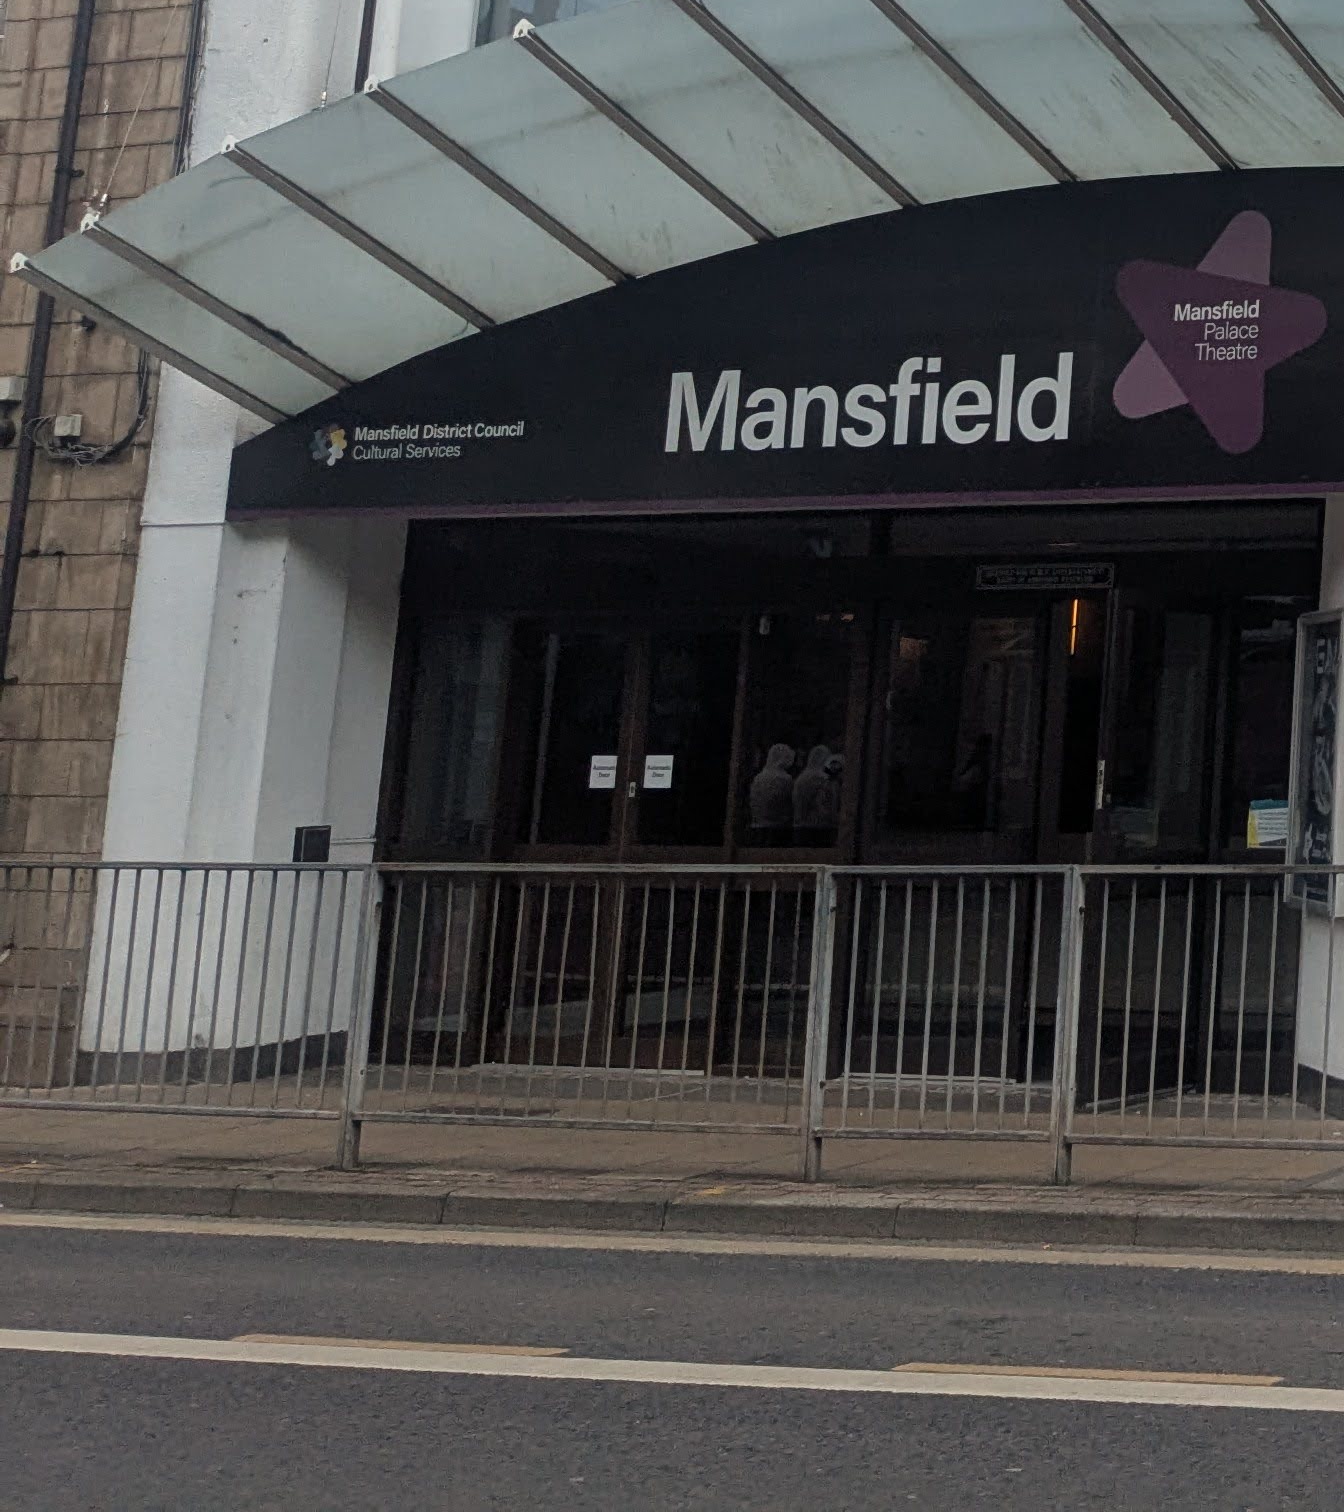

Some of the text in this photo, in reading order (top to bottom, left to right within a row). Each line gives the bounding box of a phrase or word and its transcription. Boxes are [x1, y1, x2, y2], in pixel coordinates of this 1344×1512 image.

[1174, 299, 1260, 321] Mansfield
[1204, 322, 1259, 340] Palace
[1194, 342, 1258, 361] Theatre
[664, 351, 1074, 454] Mansfield
[354, 421, 525, 442] Mansfield District Council
[353, 442, 461, 460] Cultural Services
